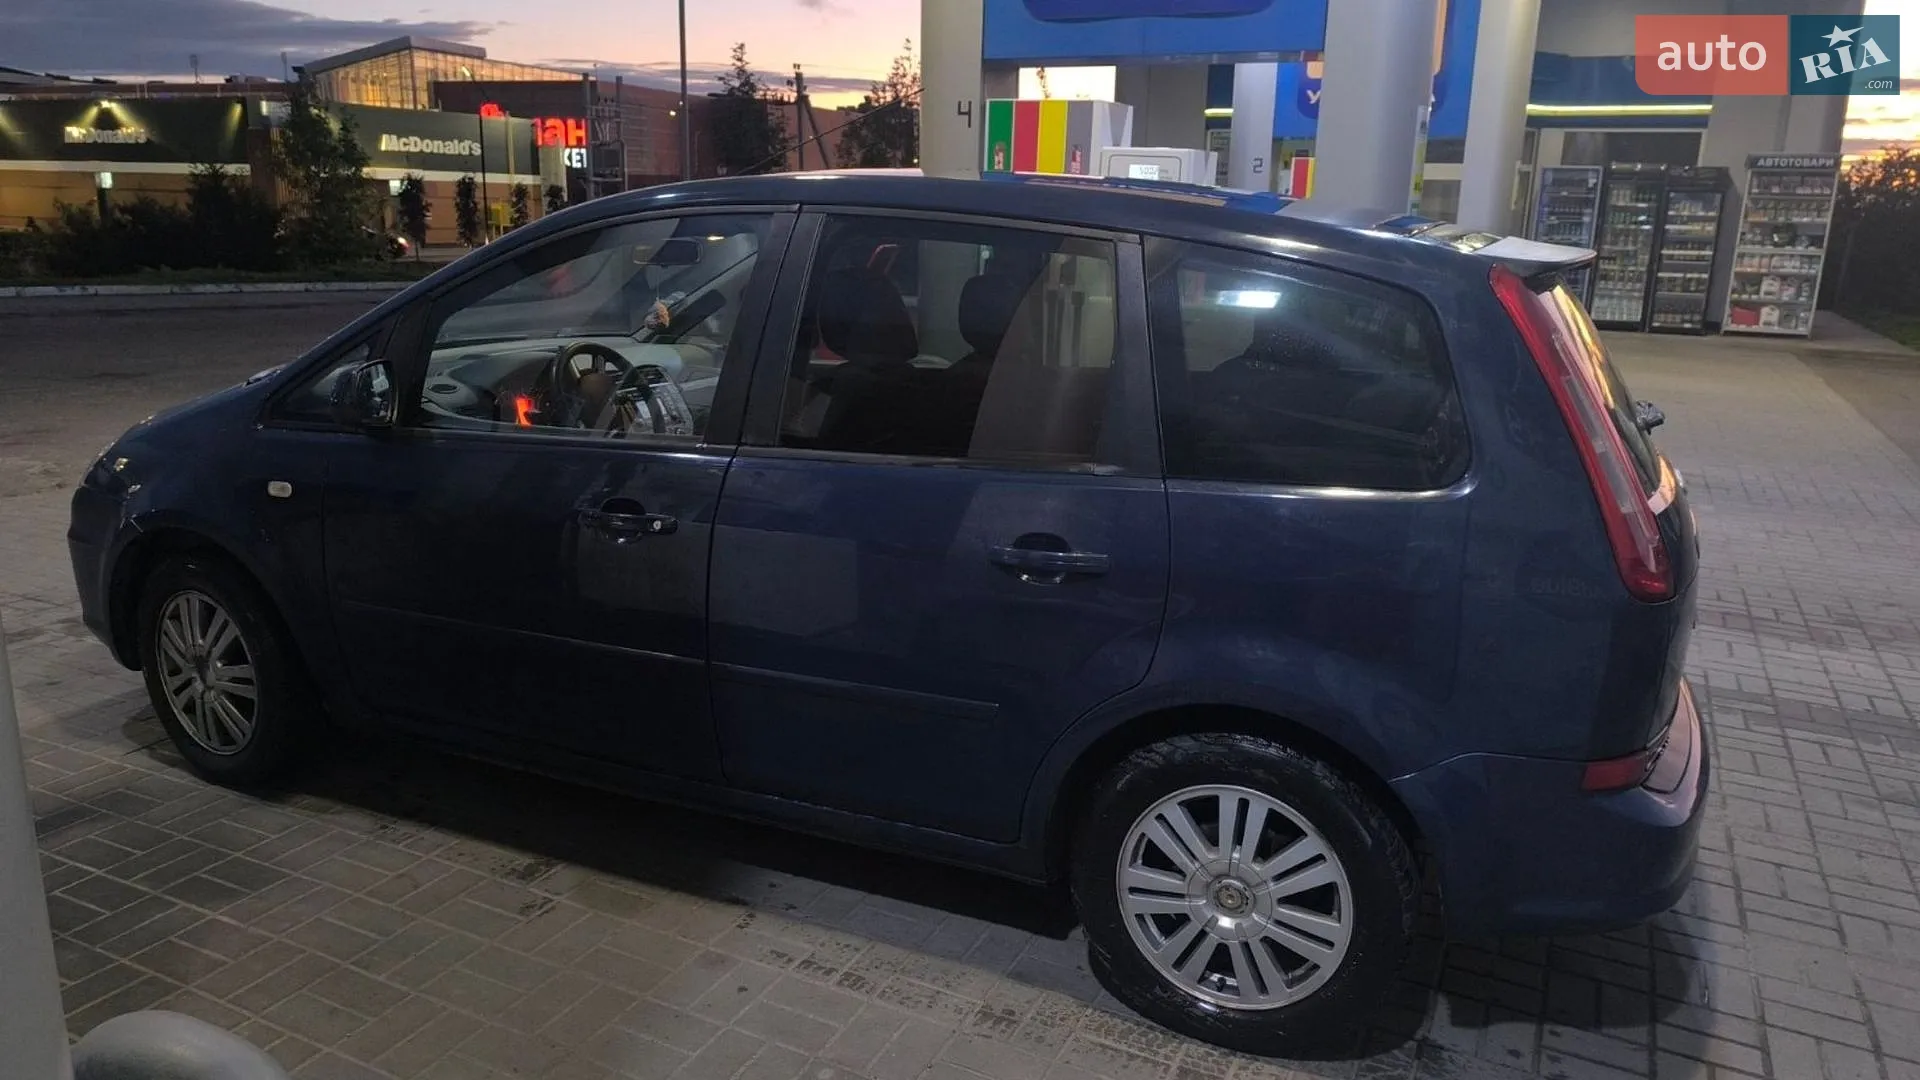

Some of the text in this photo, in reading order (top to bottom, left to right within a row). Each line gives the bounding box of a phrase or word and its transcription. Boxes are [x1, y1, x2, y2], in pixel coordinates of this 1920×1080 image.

[958, 100, 972, 129] 4
[380, 133, 481, 156] McDonald's
[1757, 157, 1835, 169] АВТОТОВАРИ
